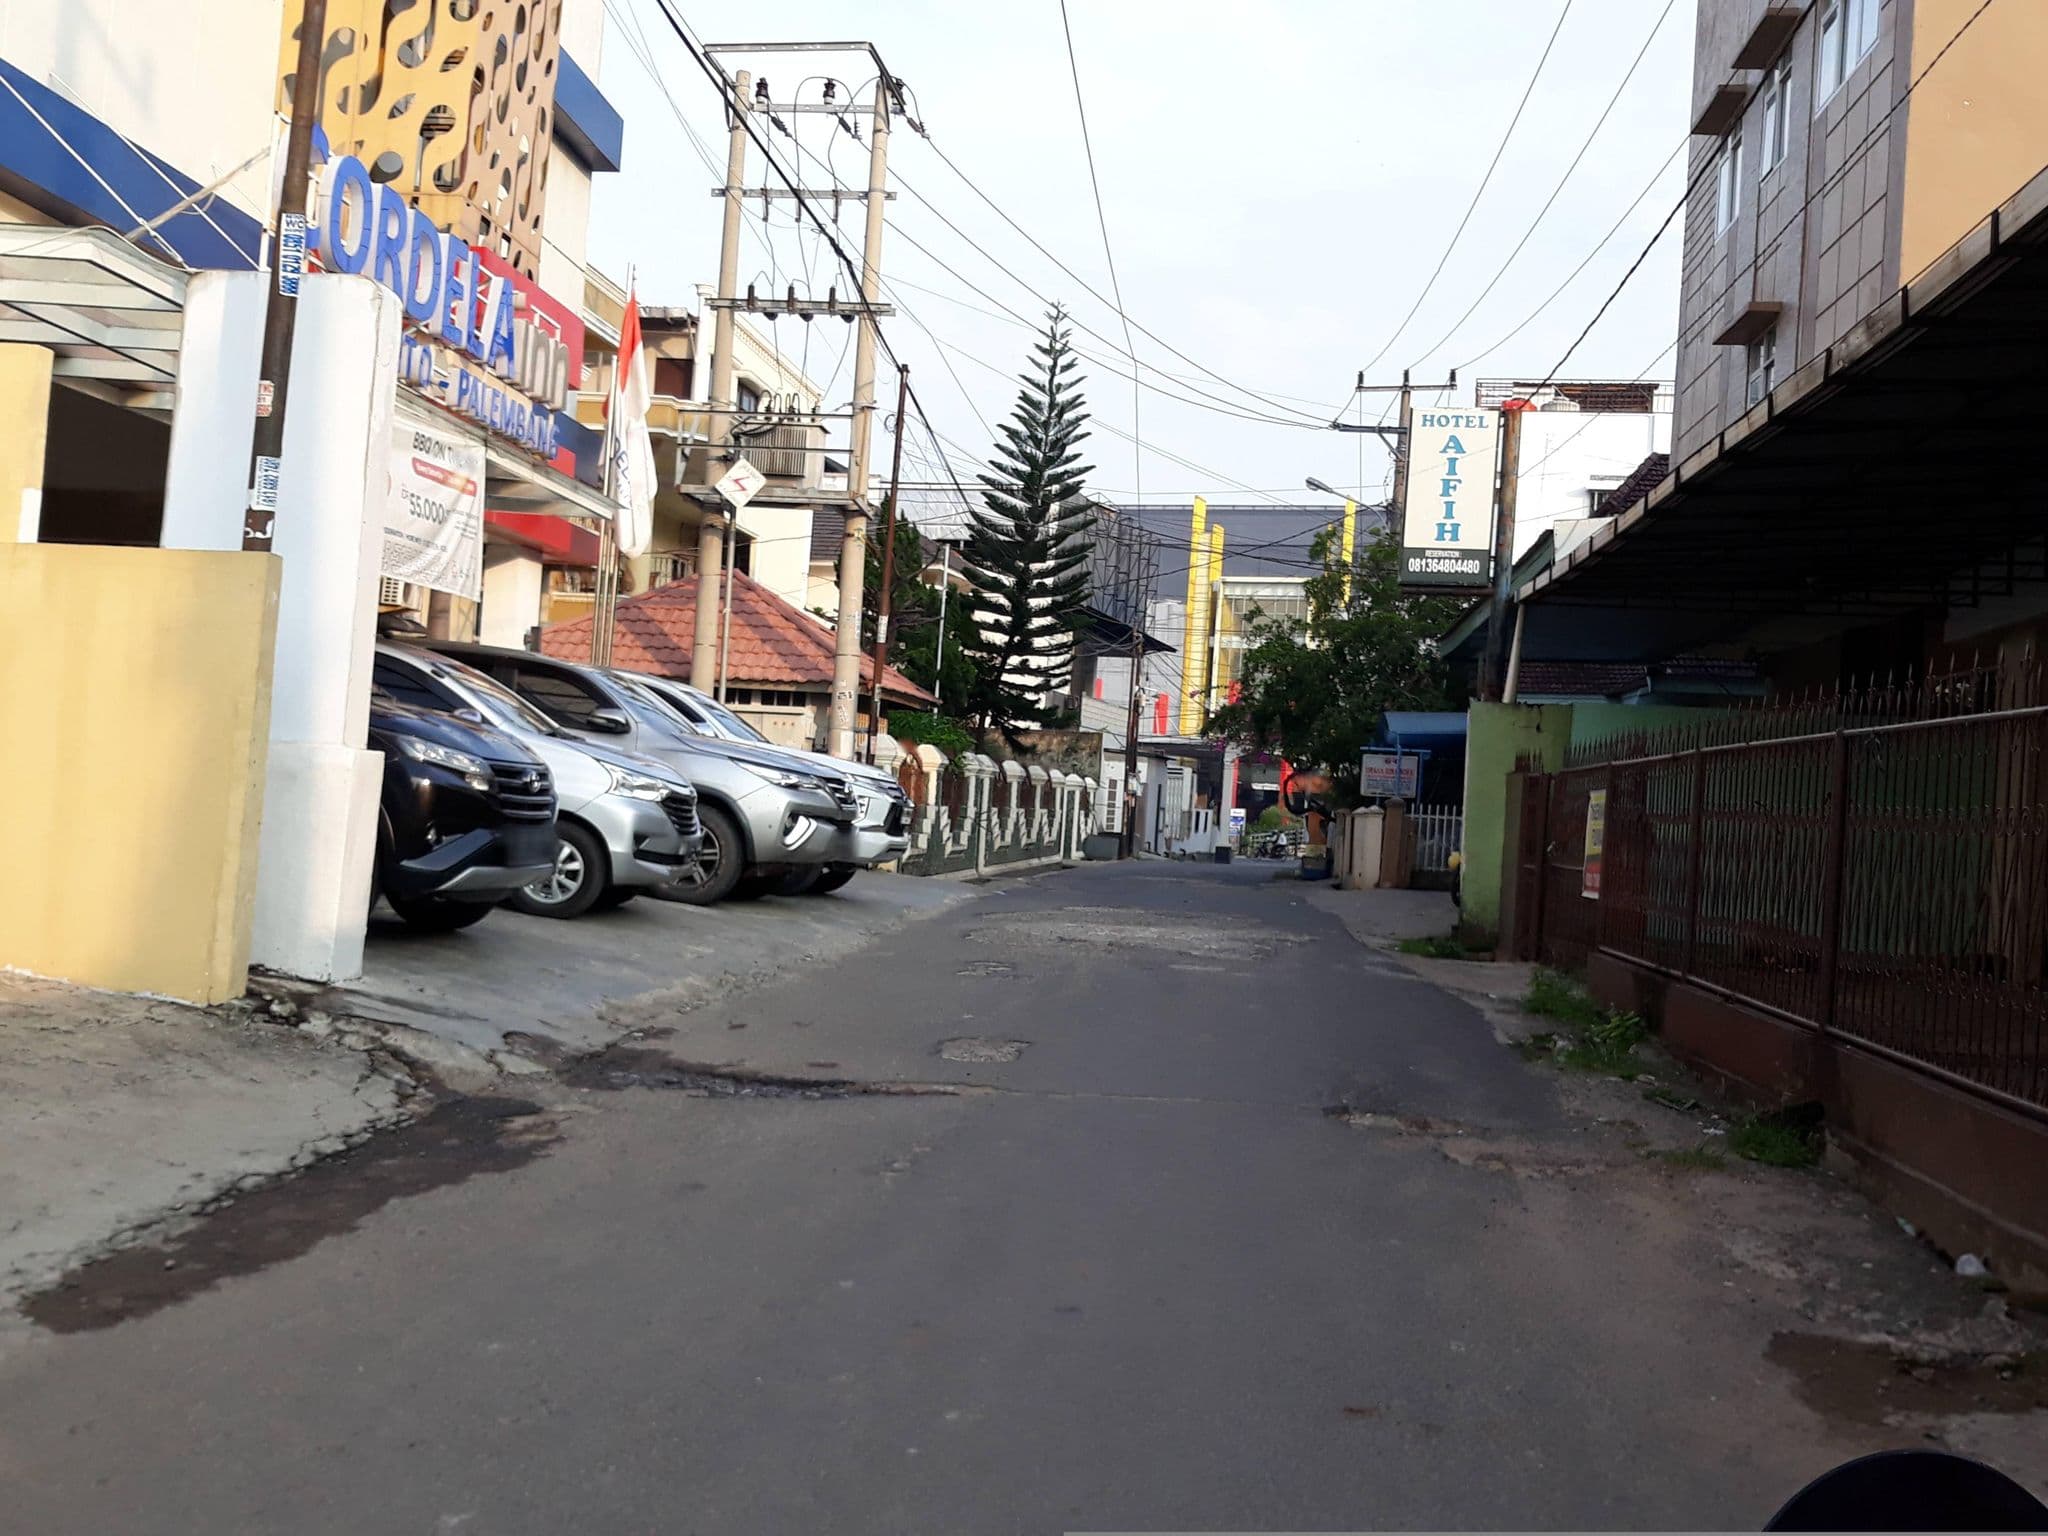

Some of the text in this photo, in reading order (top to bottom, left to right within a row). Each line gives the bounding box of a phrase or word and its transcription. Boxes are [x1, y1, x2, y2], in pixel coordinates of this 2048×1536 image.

[457, 368, 562, 460] PALEMBANG
[1421, 414, 1489, 429] HOTEL
[1435, 434, 1467, 542] AIFIH
[1408, 557, 1480, 574] 081364804480
